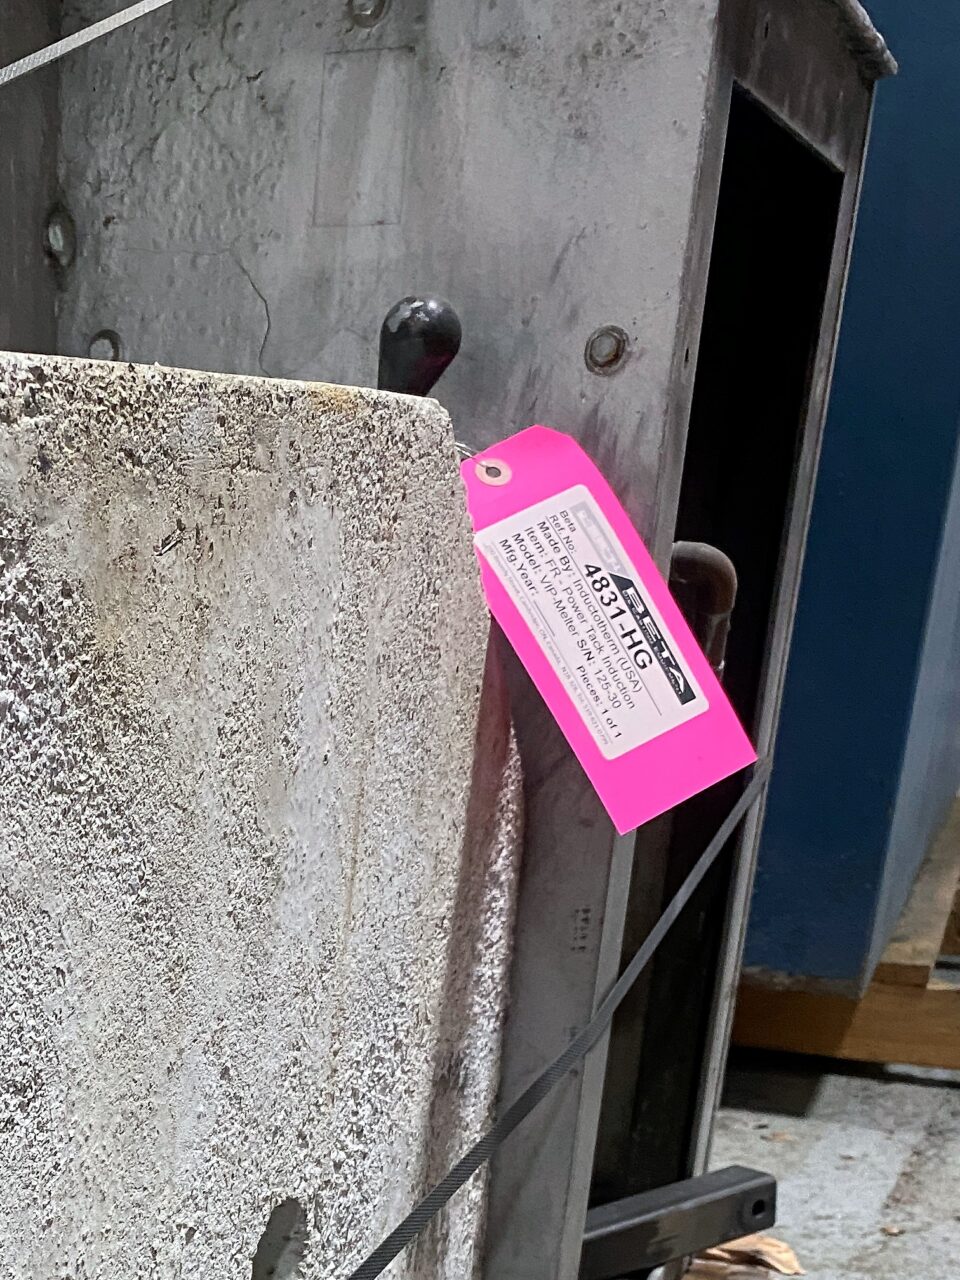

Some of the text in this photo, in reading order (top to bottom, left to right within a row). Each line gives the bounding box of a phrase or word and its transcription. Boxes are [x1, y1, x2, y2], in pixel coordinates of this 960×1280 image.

[549, 514, 577, 554] Ref. No:
[559, 509, 577, 533] Beta
[511, 532, 543, 575] Model:
[538, 574, 580, 637] VIP-Melter
[575, 637, 597, 666] S/N:
[592, 668, 622, 709] 125-30
[524, 526, 548, 558] Item:
[544, 558, 562, 578] FR
[561, 586, 589, 625] Power
[583, 625, 607, 654] Tack
[601, 655, 638, 709] Induction
[536, 520, 562, 554] Made
[556, 555, 577, 578] By:
[572, 578, 621, 655] Inductotherm
[615, 656, 643, 694] (USA)
[580, 559, 655, 671] 4831-HG
[624, 586, 689, 692] BETA
[575, 665, 604, 706] Pieces:
[600, 707, 609, 715] 1
[605, 715, 617, 729] of
[613, 730, 622, 738] 1
